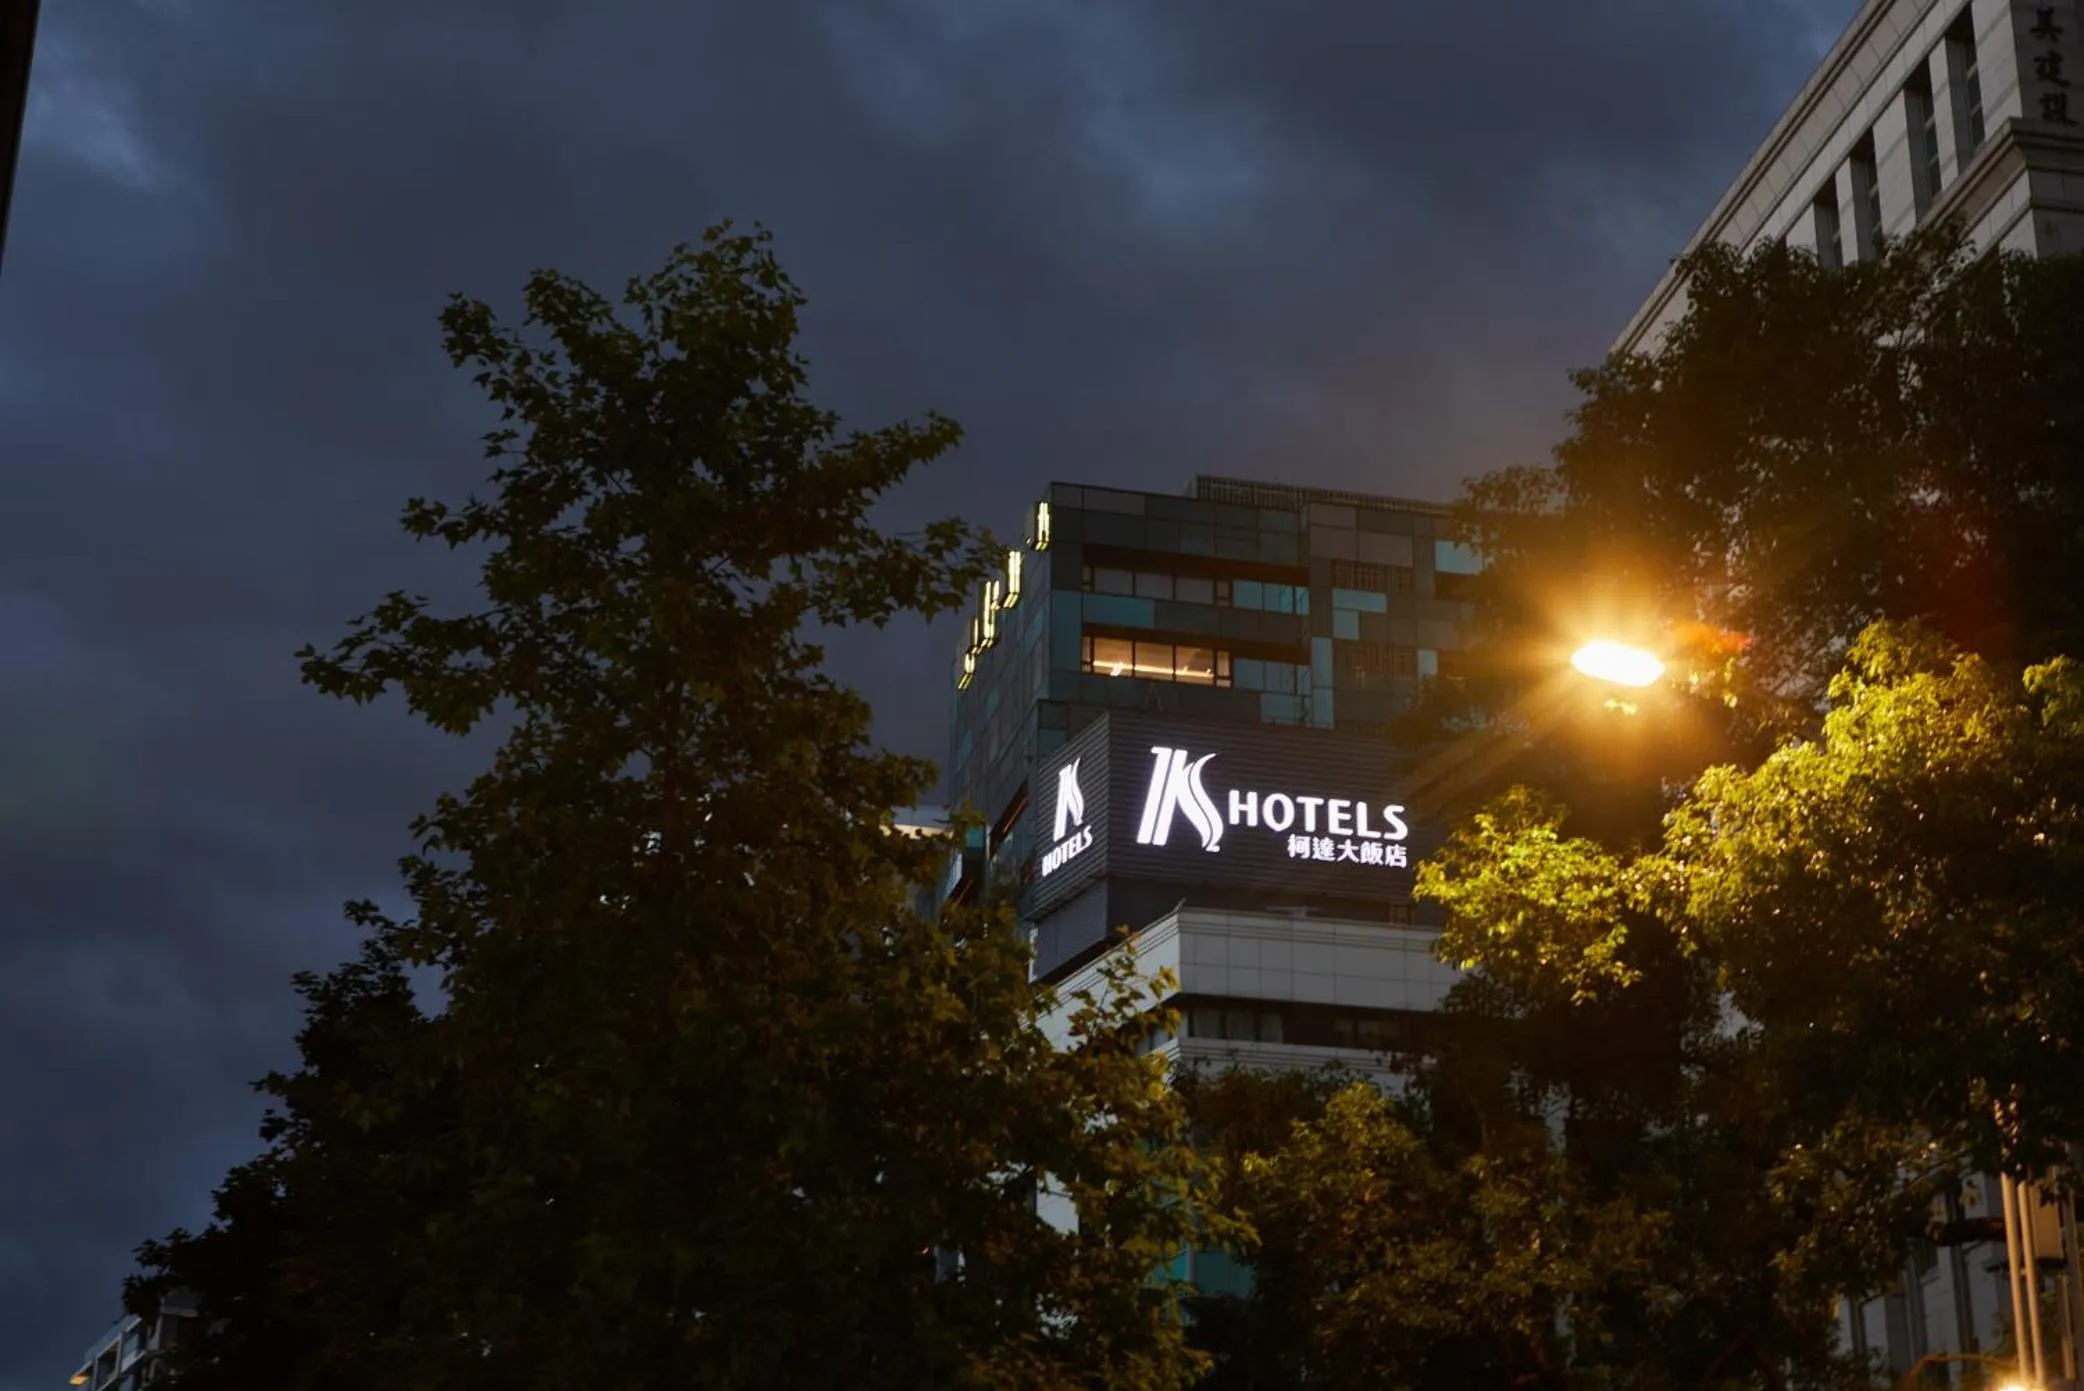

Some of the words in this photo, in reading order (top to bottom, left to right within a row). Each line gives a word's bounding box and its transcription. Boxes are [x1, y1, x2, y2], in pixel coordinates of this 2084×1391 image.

[1228, 788, 1409, 841] HOTELS
[1041, 824, 1093, 877] HOTELS
[1287, 833, 1407, 868] 柯達大飯店
